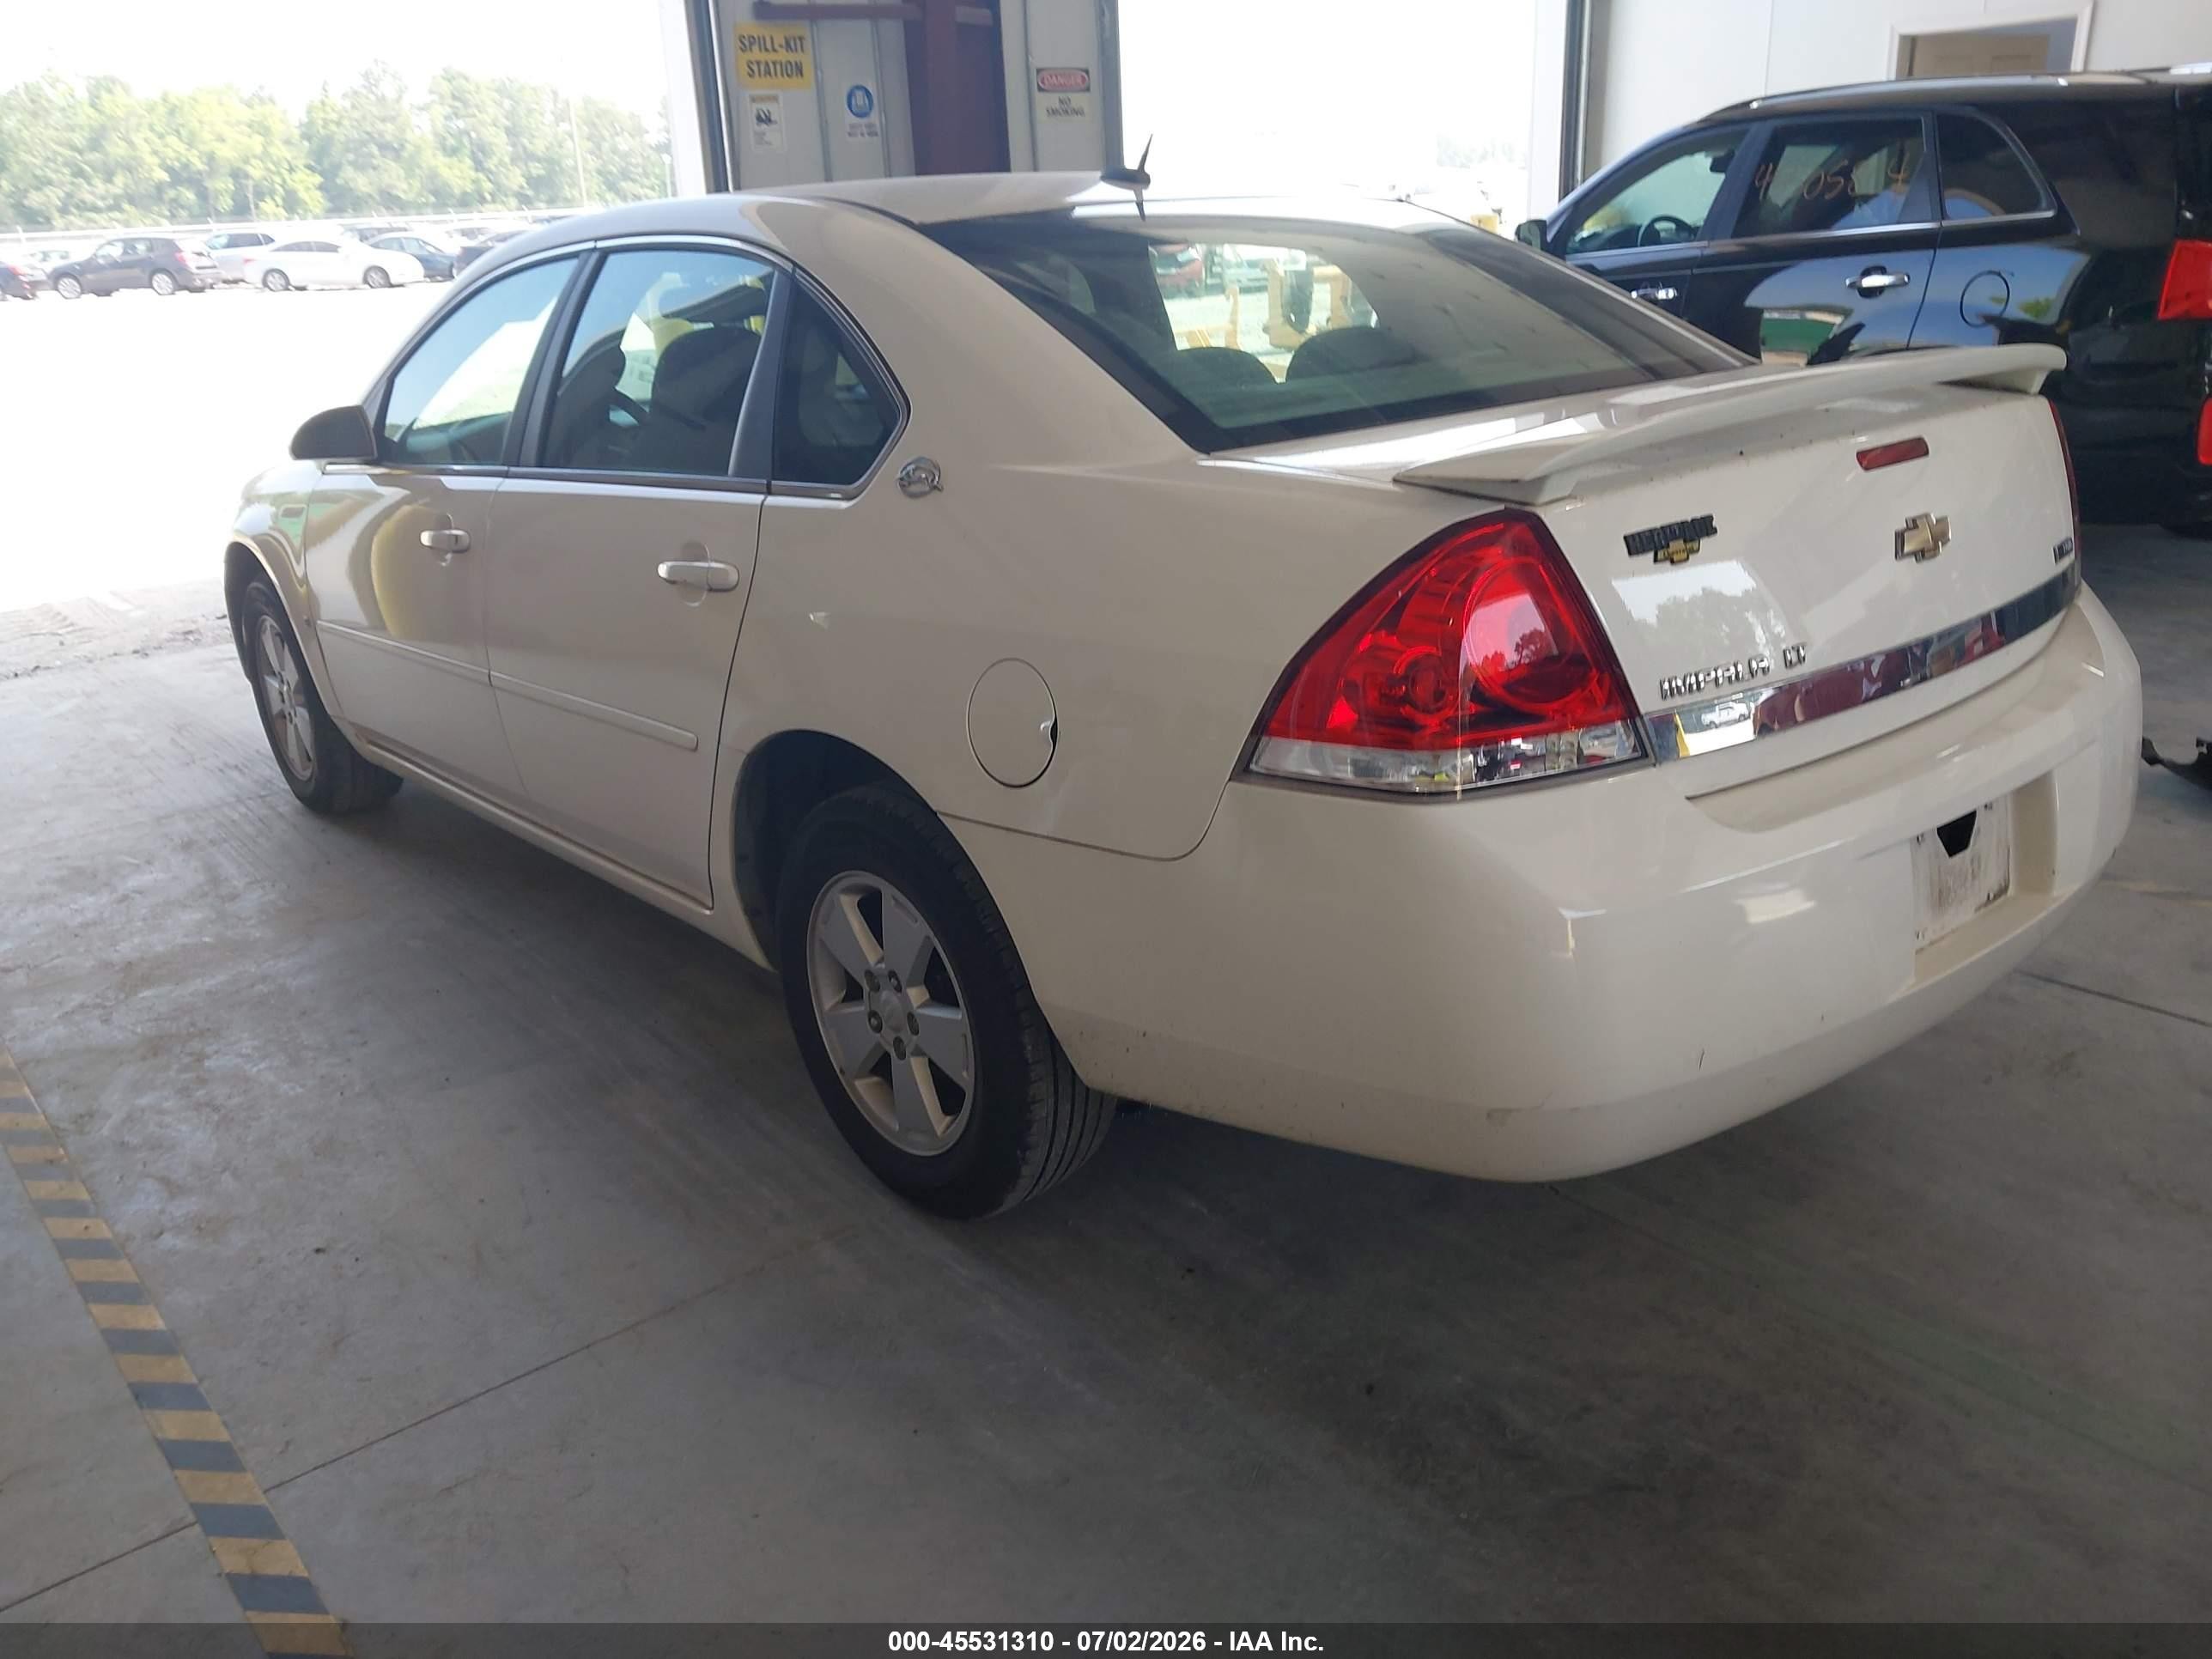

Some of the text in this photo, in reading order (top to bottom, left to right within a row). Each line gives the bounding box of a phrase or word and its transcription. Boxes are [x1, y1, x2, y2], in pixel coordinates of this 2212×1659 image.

[738, 33, 806, 54] SPILL-KIT
[746, 59, 804, 80] STATION
[1042, 73, 1084, 88] DANGER
[1058, 95, 1072, 107] NO
[1046, 106, 1085, 118] SMOKING
[1660, 654, 1771, 700] IMPALA
